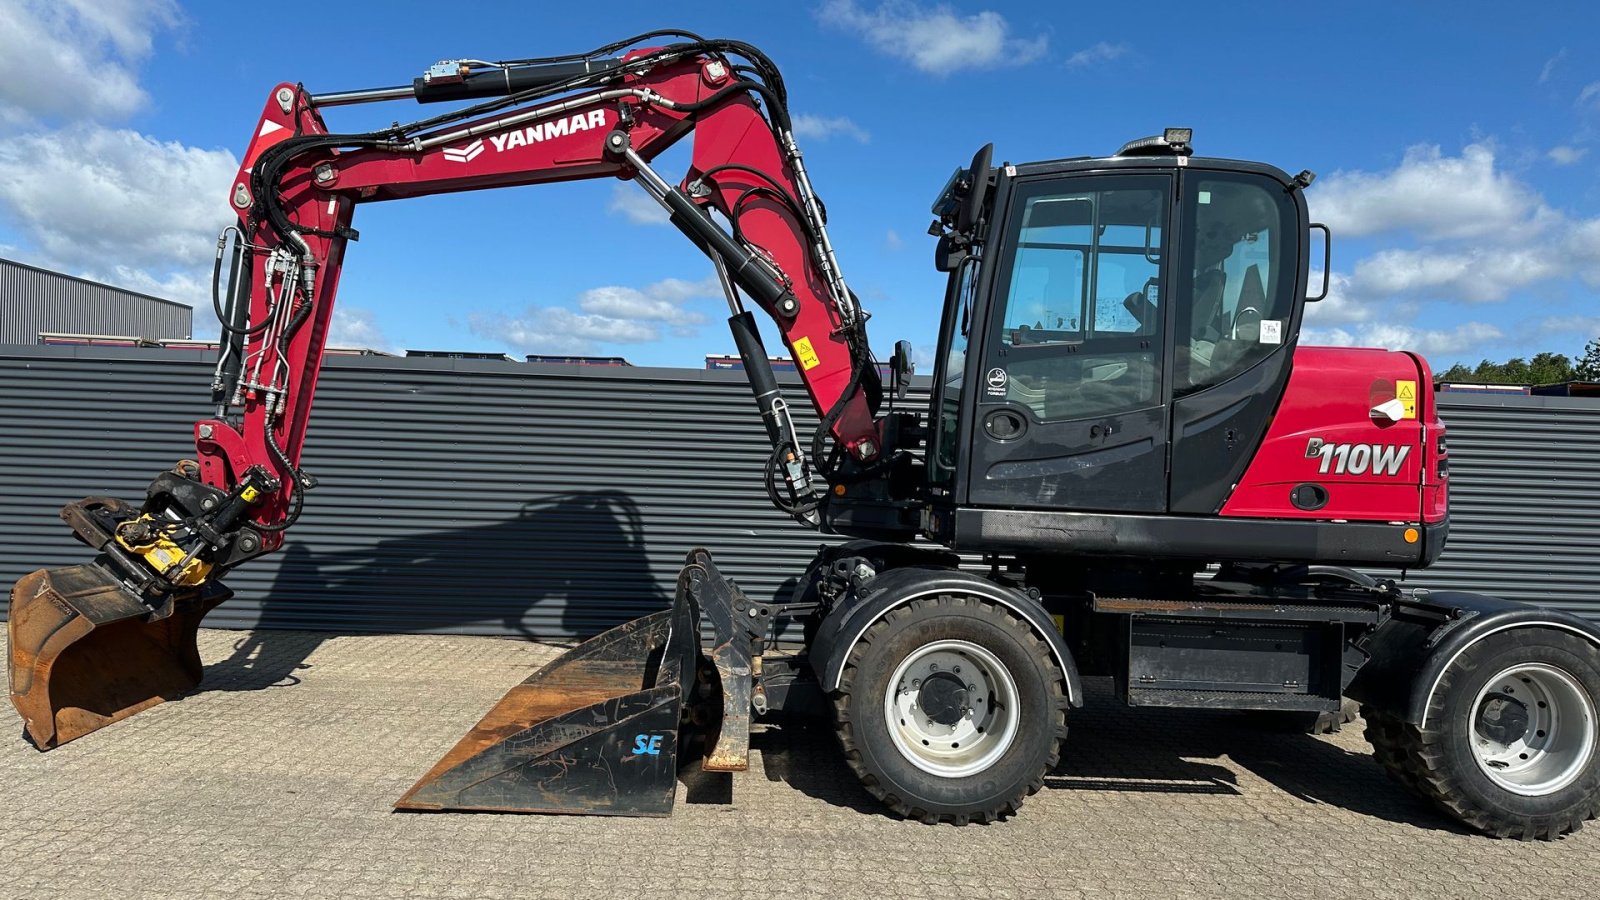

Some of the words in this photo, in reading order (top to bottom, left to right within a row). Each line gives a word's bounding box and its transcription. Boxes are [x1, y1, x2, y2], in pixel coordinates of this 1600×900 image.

[489, 108, 607, 153] YANMAR
[1304, 437, 1412, 477] B110W
[631, 734, 664, 755] SE
